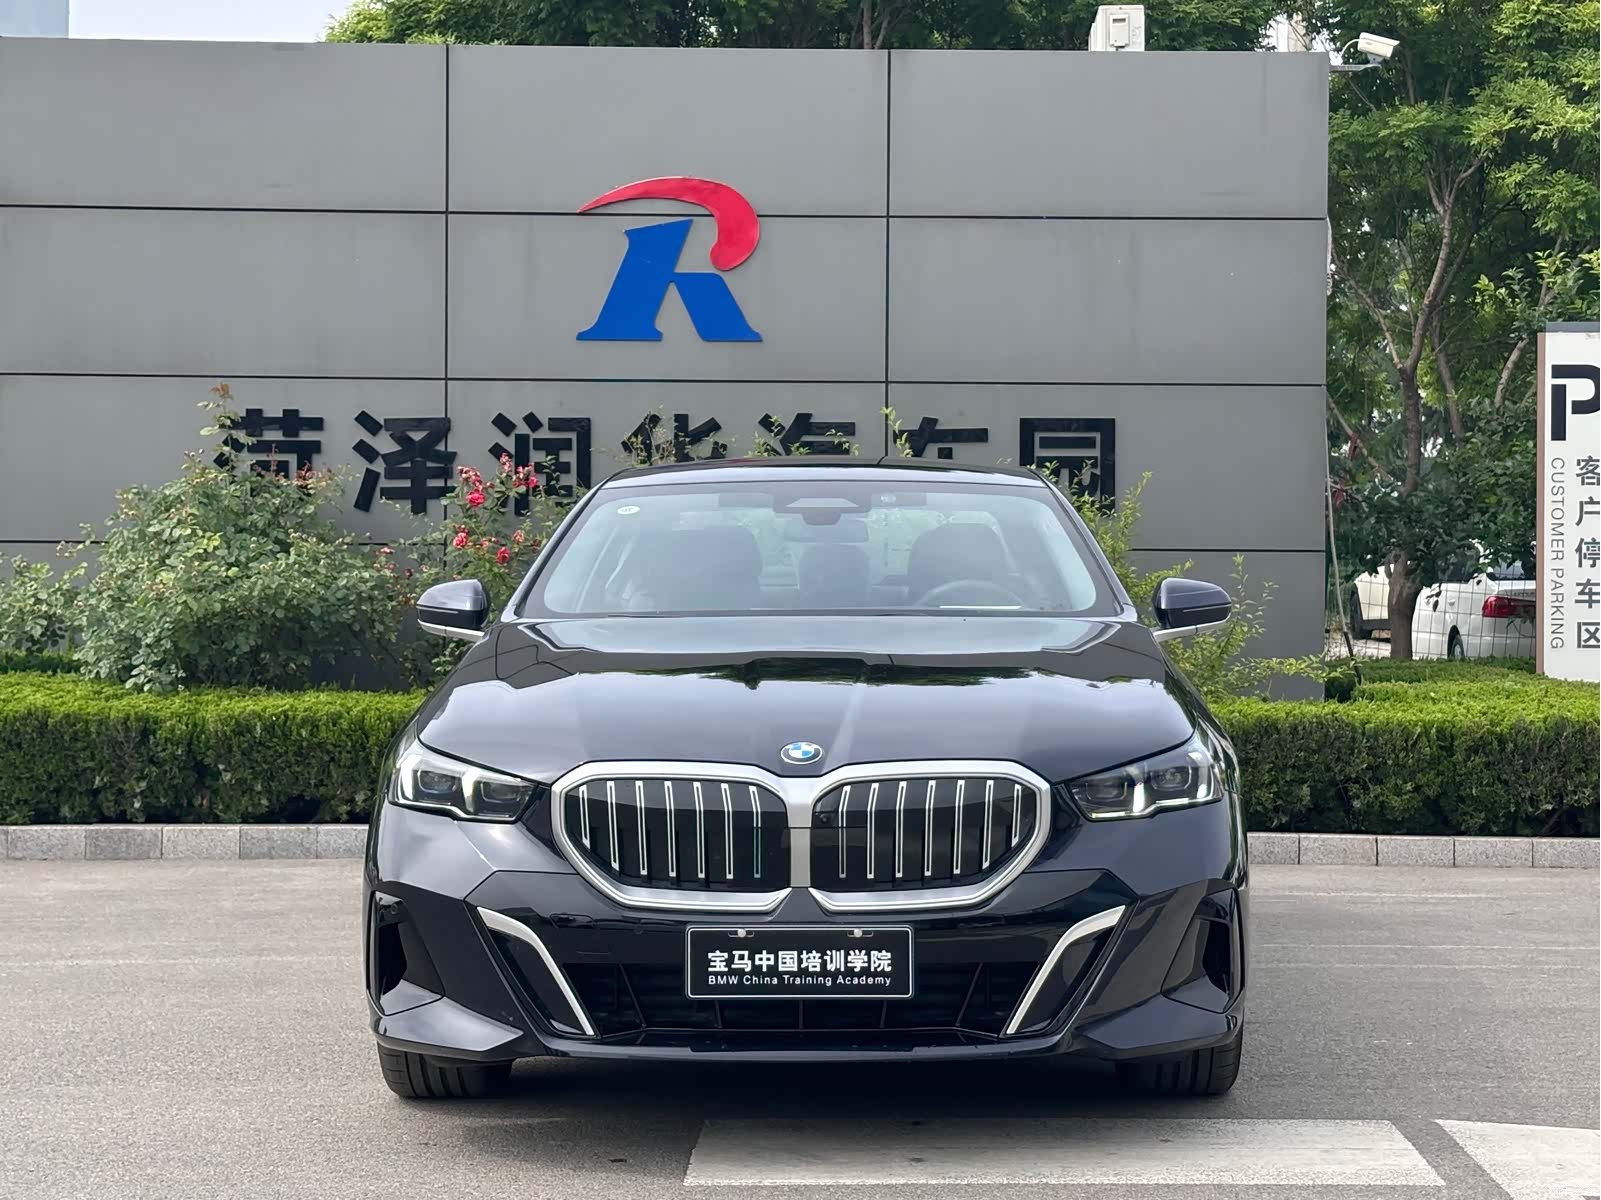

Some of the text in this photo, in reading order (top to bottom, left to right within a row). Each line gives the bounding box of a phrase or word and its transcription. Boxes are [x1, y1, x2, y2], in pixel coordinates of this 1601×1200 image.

[1551, 364, 1600, 441] P
[1550, 457, 1565, 649] CUSTOMER PARKING
[1574, 455, 1600, 649] 客户停车区
[707, 949, 892, 972] 宝马中国培训学院
[708, 975, 892, 986] BMW China Training Academy
